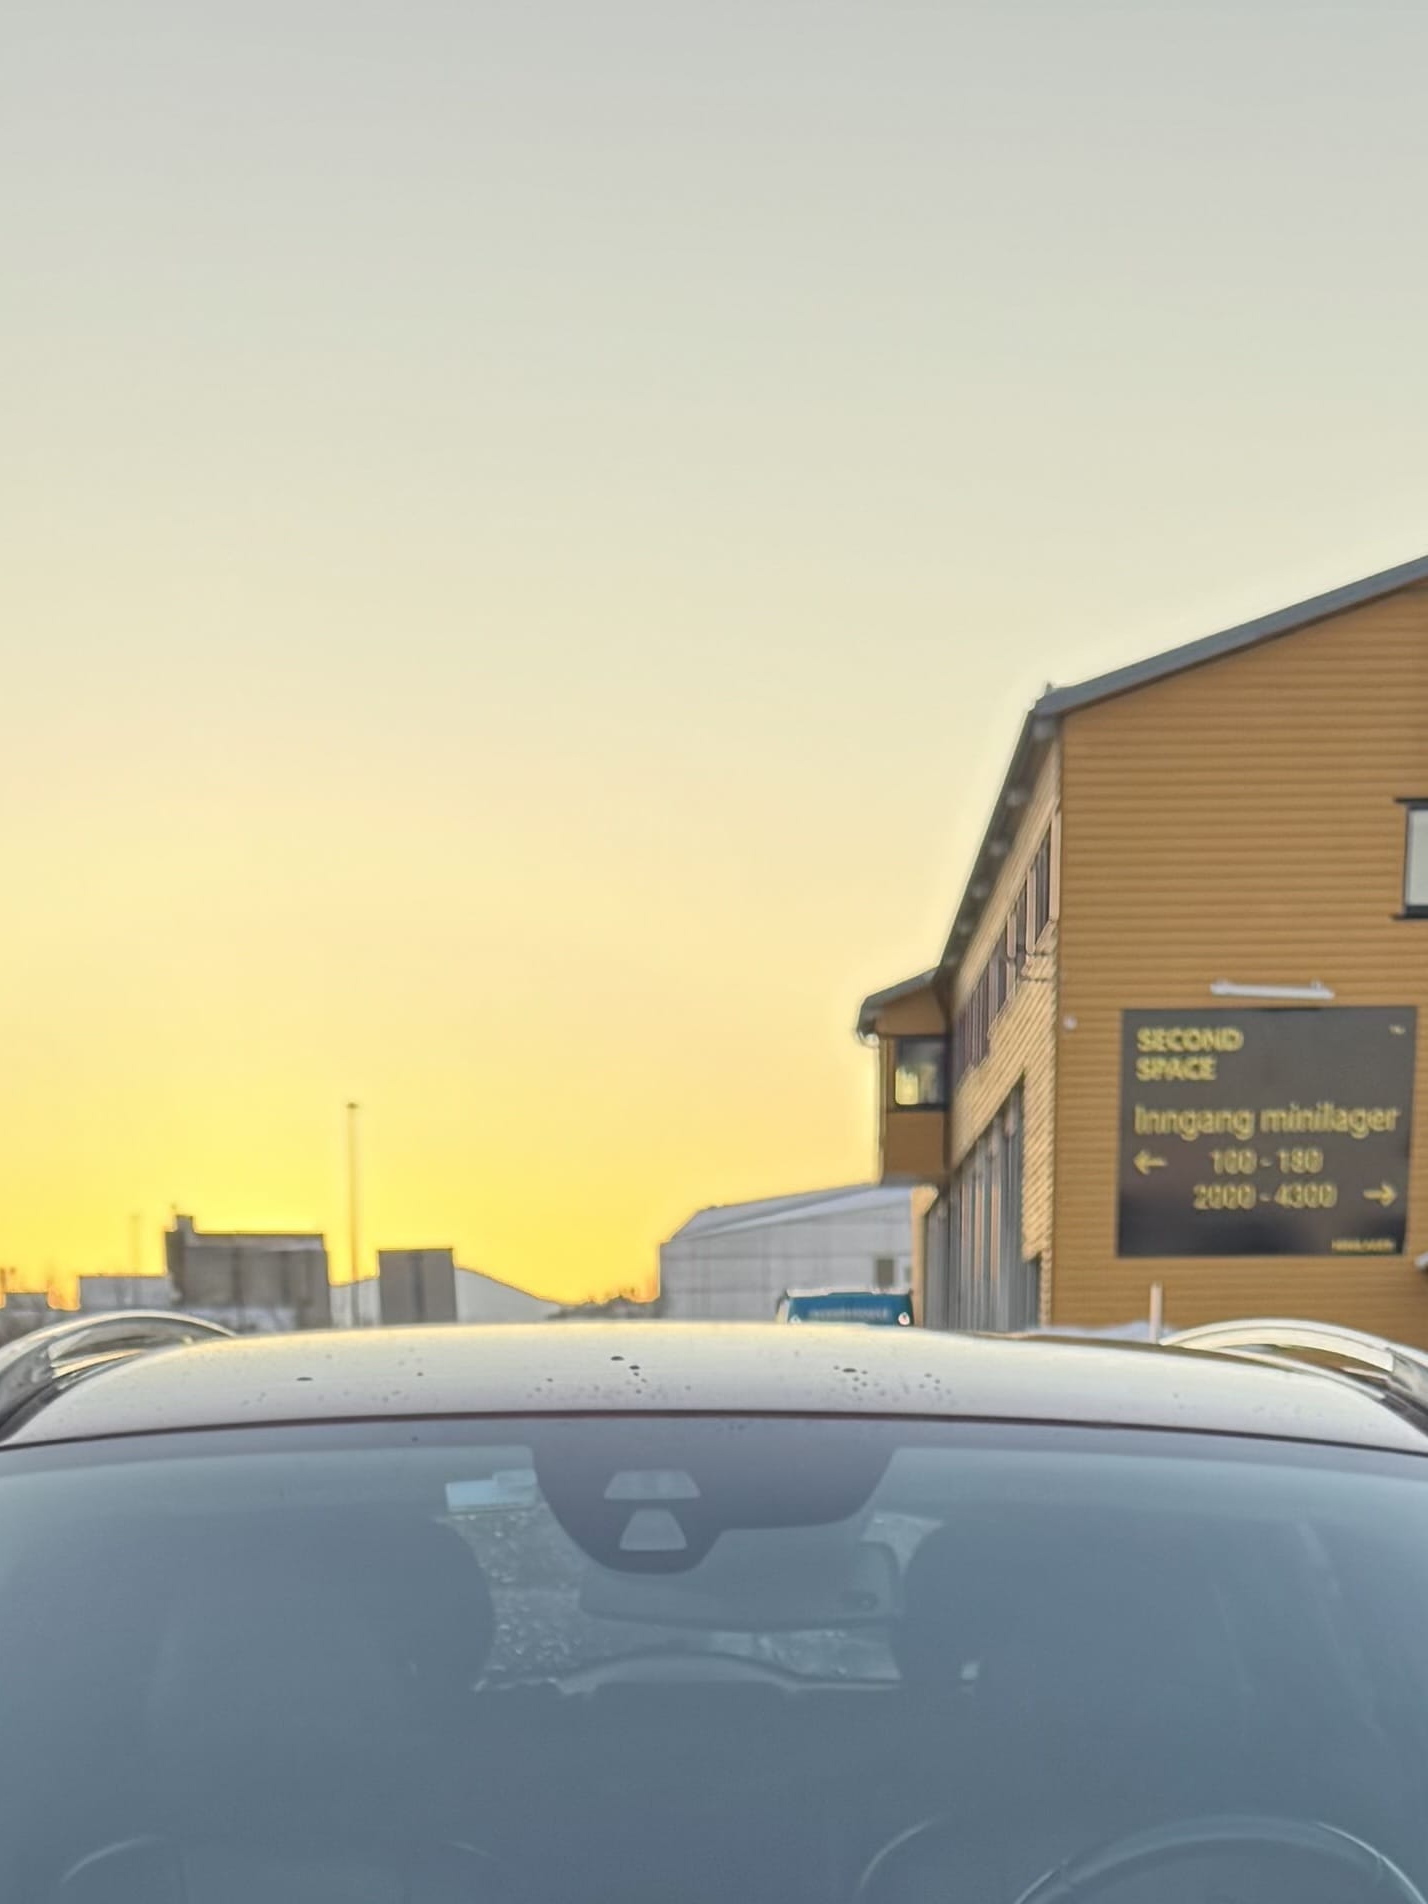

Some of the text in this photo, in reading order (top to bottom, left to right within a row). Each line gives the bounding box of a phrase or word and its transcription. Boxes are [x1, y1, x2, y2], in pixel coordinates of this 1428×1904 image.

[1135, 1026, 1245, 1052] SECOND
[1135, 1056, 1217, 1081] SPACE
[1133, 1101, 1399, 1141] Inngang minilager
[1209, 1148, 1257, 1174] 100
[1276, 1147, 1323, 1174] 180
[1193, 1183, 1256, 1210] 2000
